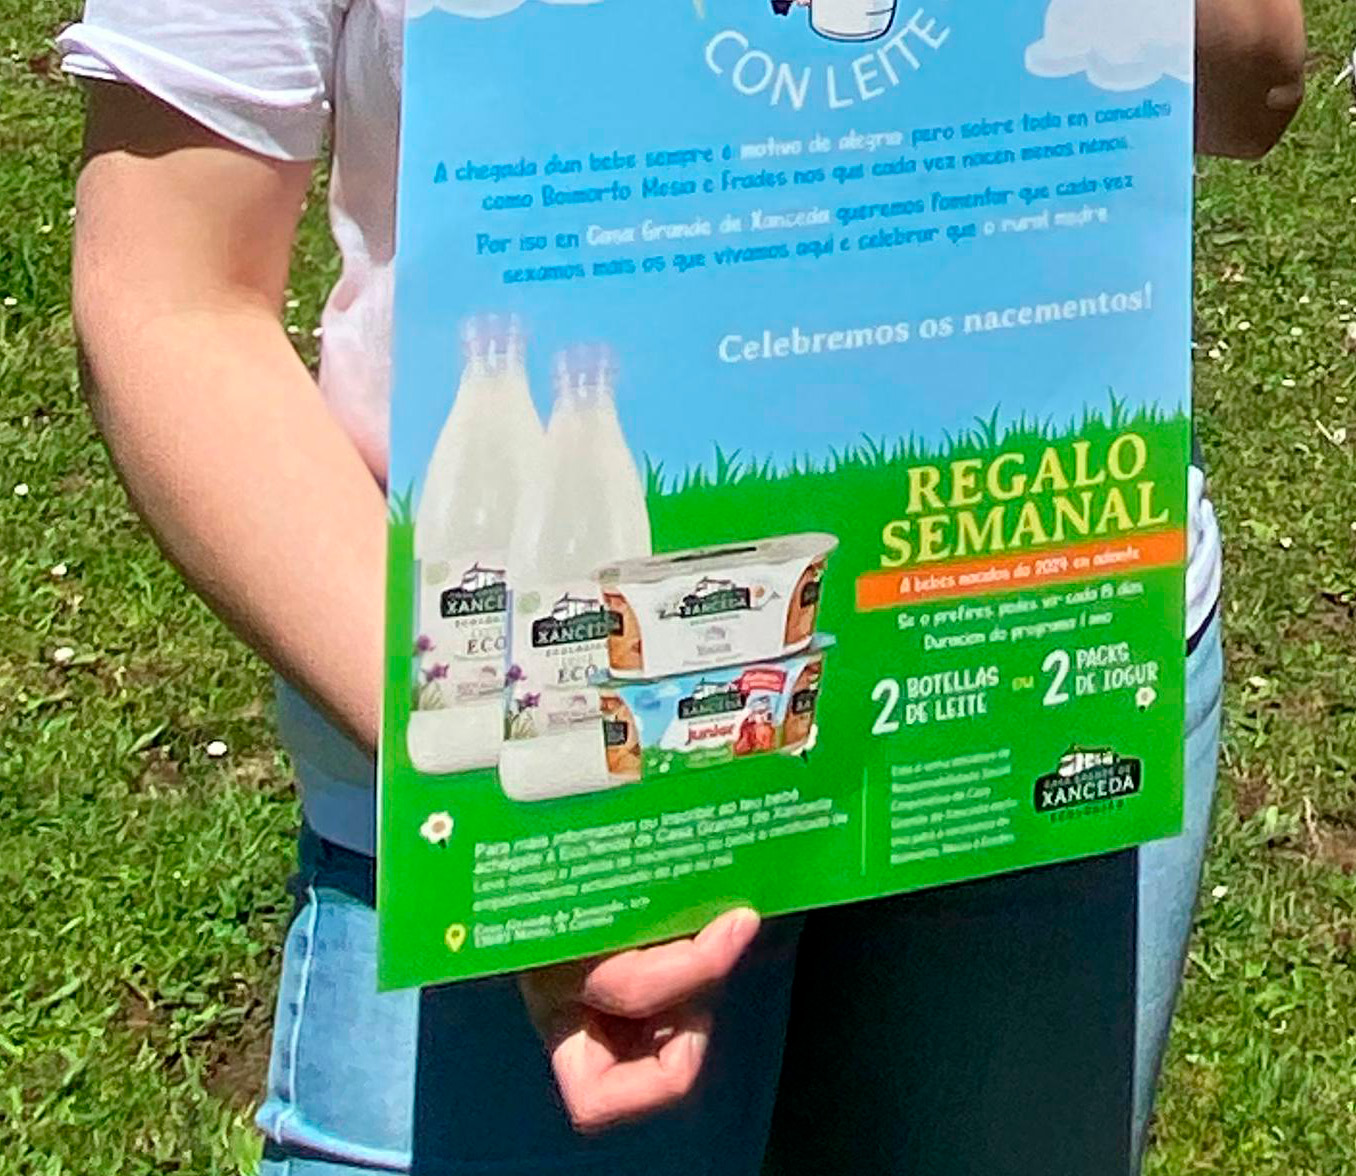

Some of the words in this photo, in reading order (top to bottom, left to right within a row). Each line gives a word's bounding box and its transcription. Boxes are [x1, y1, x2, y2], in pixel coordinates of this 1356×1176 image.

[705, 30, 811, 111] CON
[827, 8, 950, 109] LEITE
[434, 161, 448, 183] A
[808, 133, 831, 153] de
[1067, 113, 1088, 128] en
[476, 233, 511, 255] Por
[556, 233, 579, 248] en
[719, 322, 909, 364] Celebremos
[919, 314, 953, 339] os
[963, 281, 1153, 335] nacementos!
[905, 433, 1147, 515] REGALO
[880, 481, 1170, 568] SEMANAL
[900, 577, 910, 593] A
[871, 678, 900, 735] 2
[906, 666, 999, 700] BOTELLAS
[1042, 649, 1070, 706] 2
[1075, 641, 1130, 670] PACKS
[1075, 674, 1097, 697] DE
[1103, 661, 1159, 691] IOGUR
[905, 702, 929, 725] DE
[935, 692, 988, 722] LEITE
[1041, 775, 1135, 808] XANCEDA
